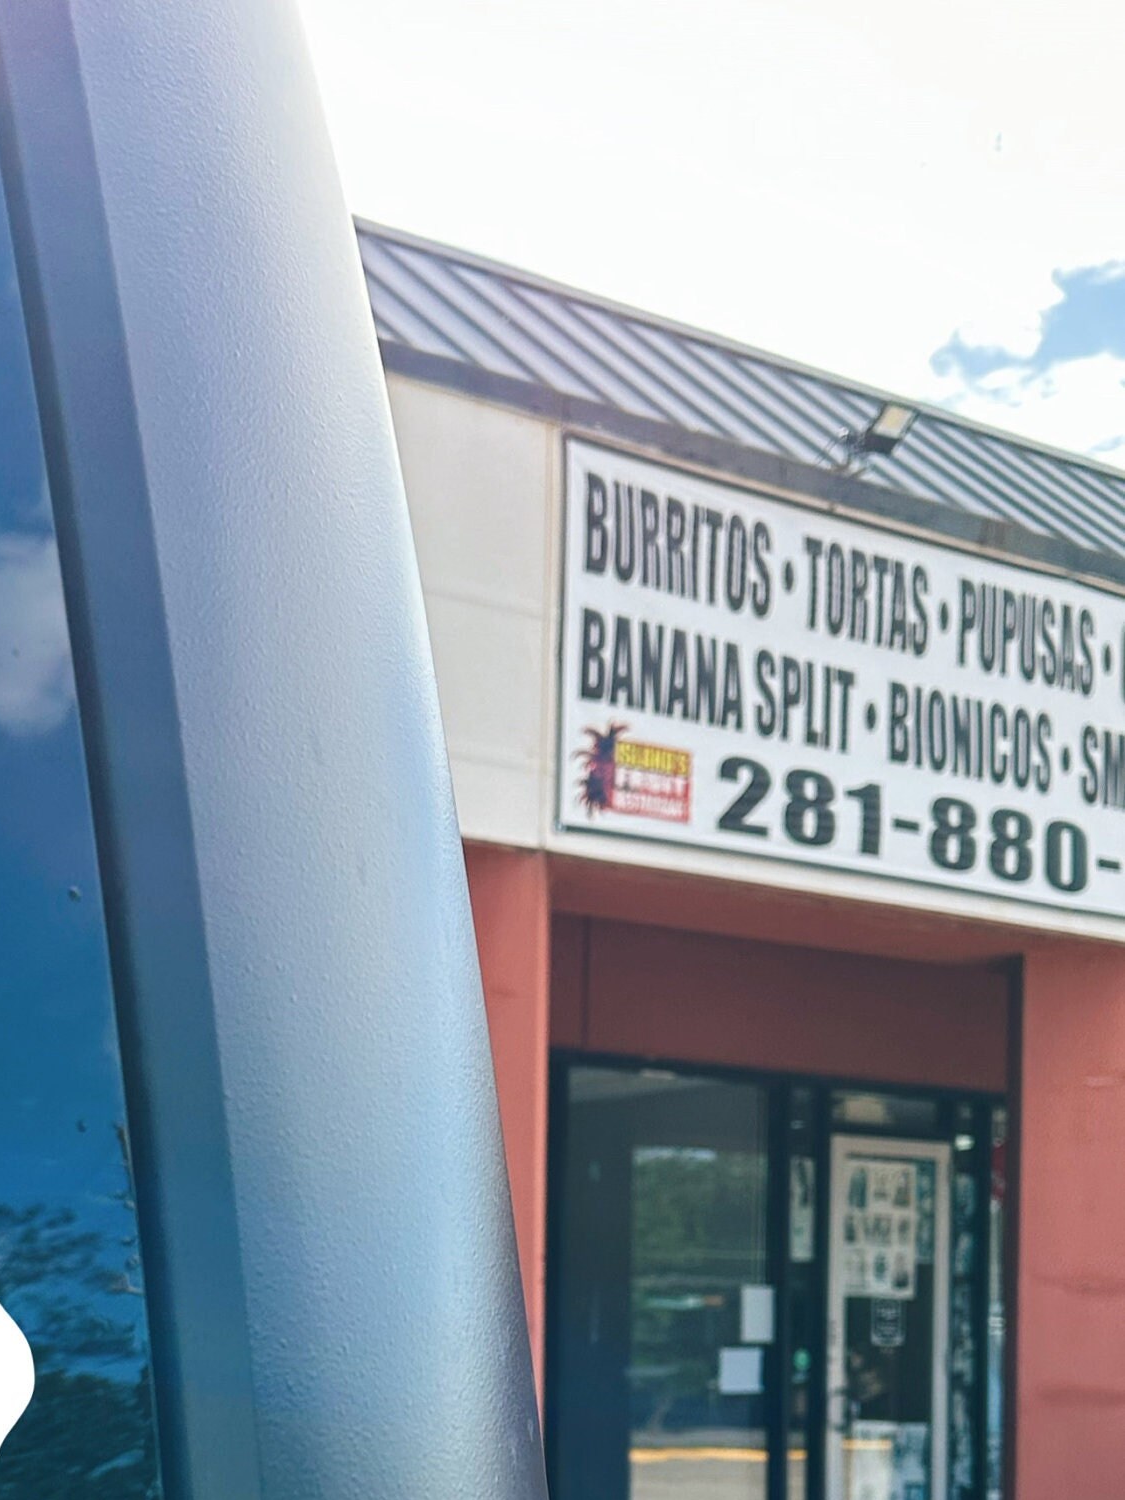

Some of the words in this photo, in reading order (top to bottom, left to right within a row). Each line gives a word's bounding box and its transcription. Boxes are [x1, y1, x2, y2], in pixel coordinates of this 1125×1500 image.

[584, 471, 772, 619] BURRITOS
[805, 535, 929, 658] TORTAS
[959, 578, 1095, 697] PUPUSAS
[579, 606, 744, 732] BANANA
[756, 648, 856, 754] SPLIT
[889, 681, 1052, 794] BIONICOS
[717, 755, 1121, 893] 281-880-
